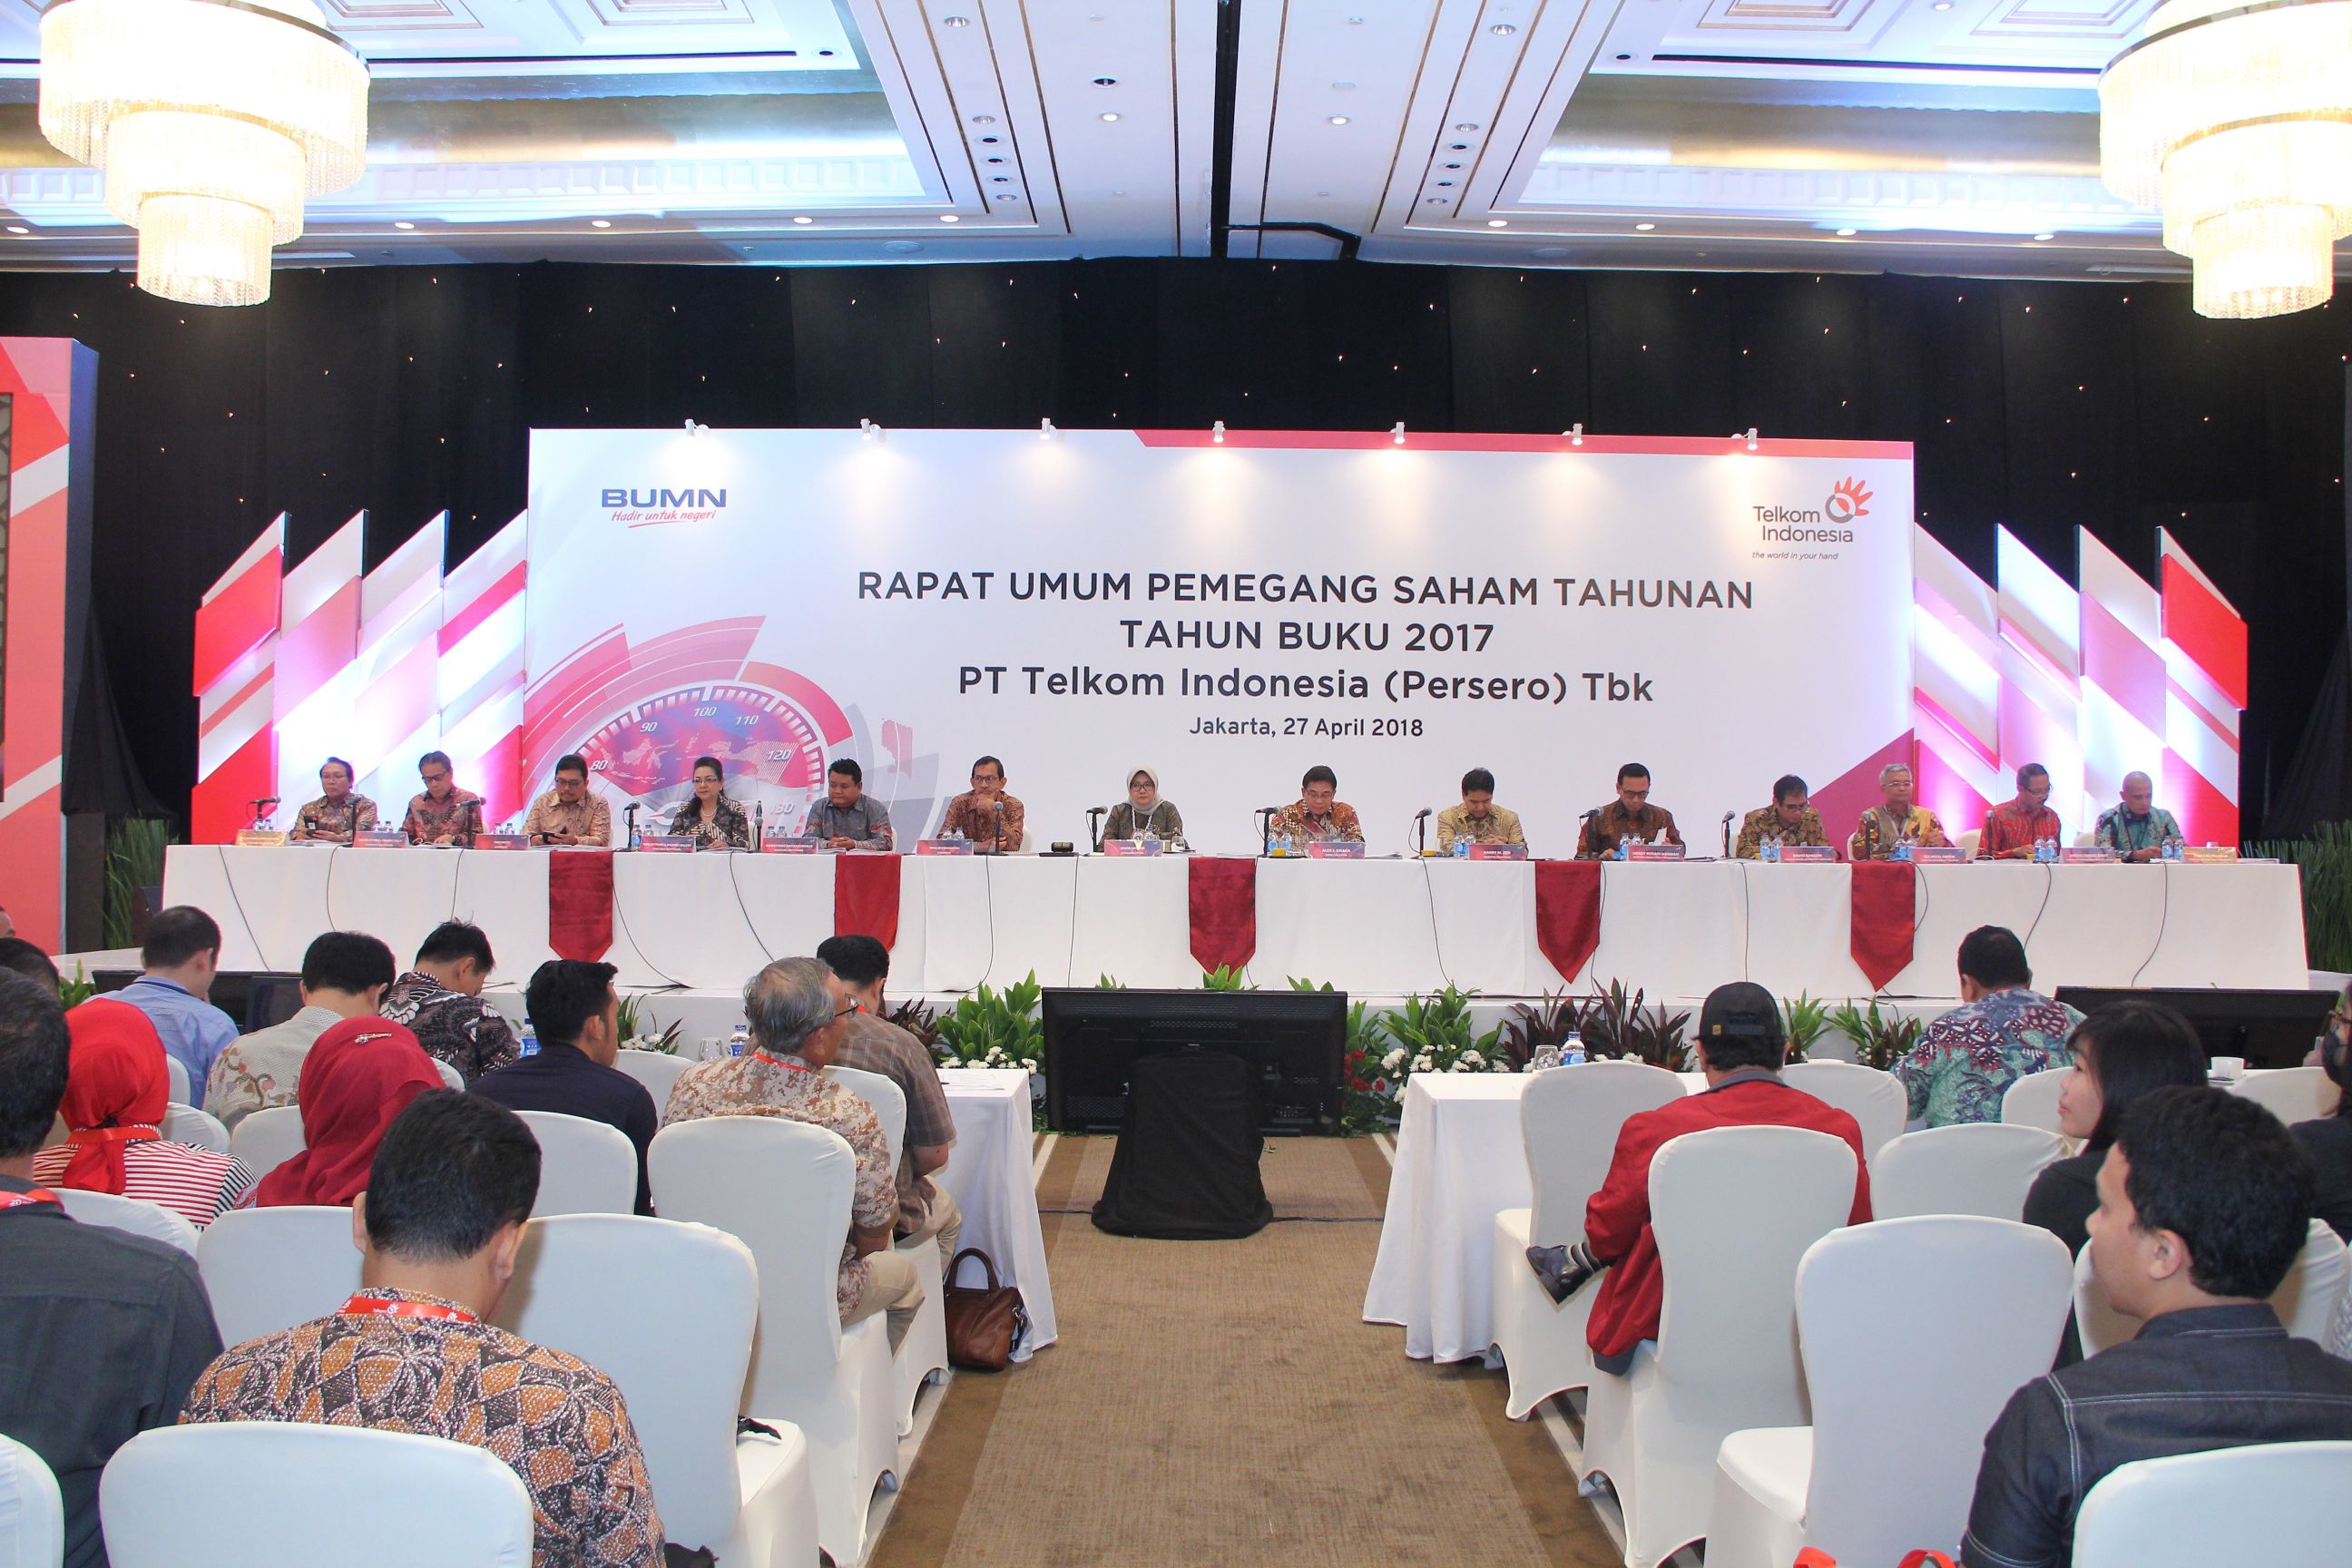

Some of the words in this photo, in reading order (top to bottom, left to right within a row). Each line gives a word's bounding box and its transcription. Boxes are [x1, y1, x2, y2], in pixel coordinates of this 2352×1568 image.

[601, 488, 727, 508] BUMN
[611, 510, 643, 522] Hadir
[644, 509, 678, 521] untuk
[680, 509, 717, 523] negeri
[1752, 505, 1820, 524] Telkom
[1762, 524, 1854, 543] Indonesia
[1751, 551, 1766, 559] the
[1767, 552, 1789, 560] world
[1798, 553, 1817, 561] your
[1818, 552, 1839, 561] hand
[858, 571, 995, 600] RAPAT
[1010, 572, 1131, 601] UMUM
[1148, 573, 1377, 604] PEMEGANG
[1393, 575, 1538, 606] SAHAM
[1553, 578, 1752, 610] TAHUNAN
[1119, 619, 1261, 650] TAHUN
[1279, 621, 1389, 652] BUKU
[1405, 622, 1494, 652] 2017
[959, 665, 1008, 695] PT
[1021, 665, 1164, 696] Telkom
[1181, 667, 1368, 699] Indonesia
[1384, 670, 1567, 705] (Persero)
[1582, 671, 1654, 702] Tbk
[693, 706, 717, 718] 100
[735, 714, 760, 726] 110
[640, 721, 658, 733] 90
[1189, 716, 1277, 739] Jakarta,
[1282, 717, 1309, 736] 27
[1314, 717, 1365, 740] April
[1371, 718, 1424, 738] 2018
[767, 750, 792, 761] 120
[590, 760, 609, 771] 80
